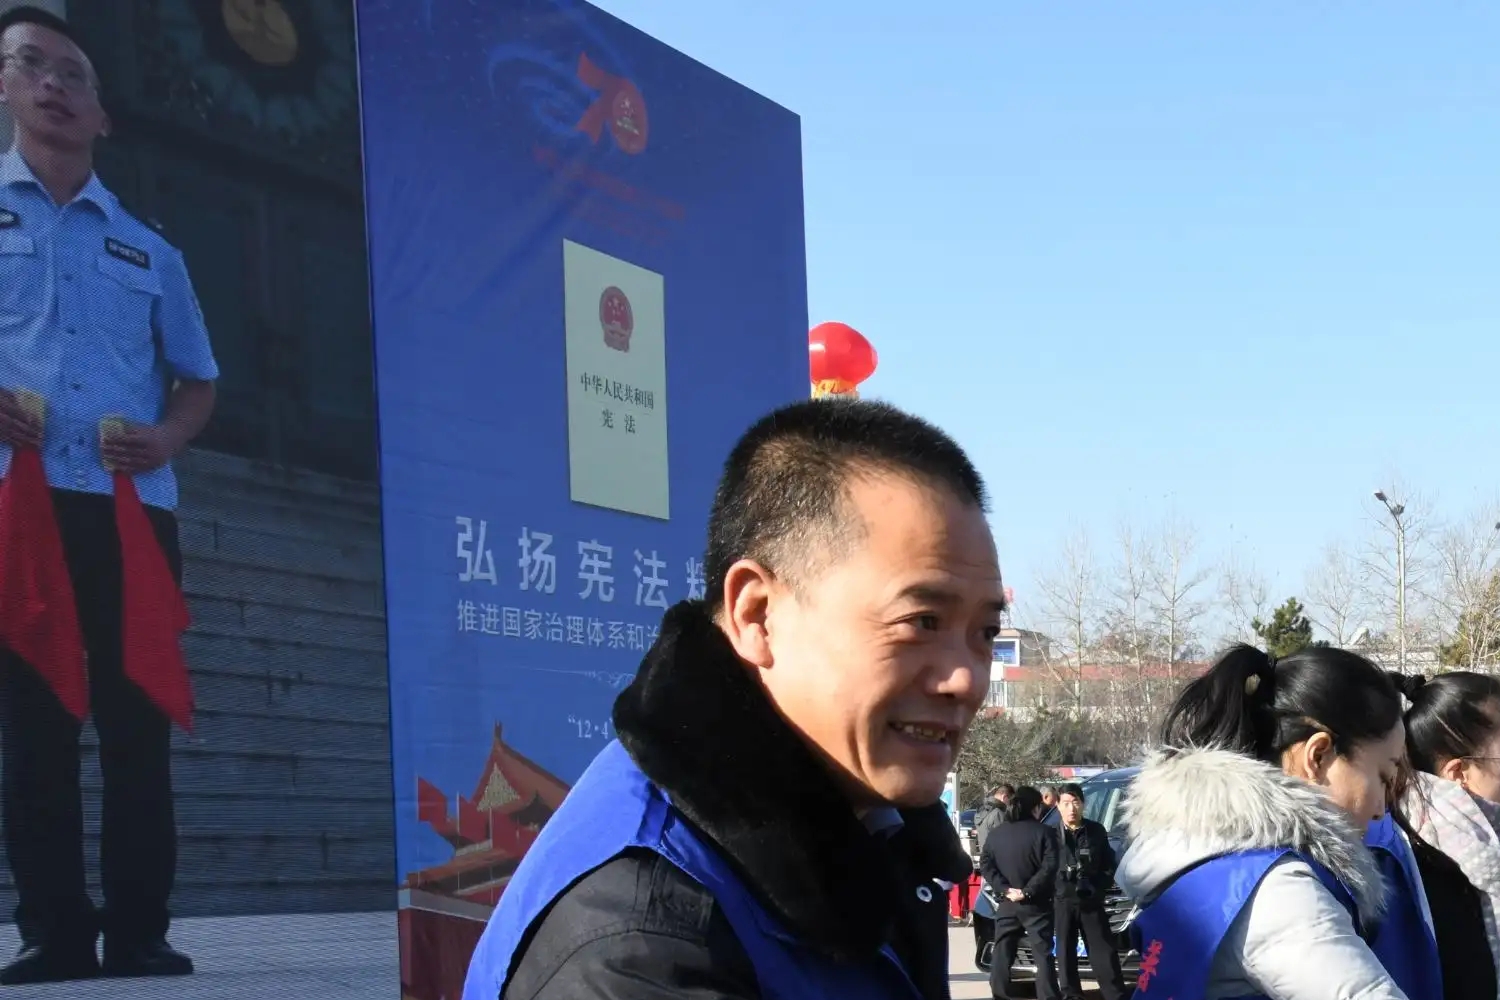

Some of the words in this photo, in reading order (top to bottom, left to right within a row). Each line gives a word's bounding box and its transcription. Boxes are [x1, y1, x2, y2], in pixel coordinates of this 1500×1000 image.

[580, 371, 654, 410] 中华人民共和国
[602, 408, 636, 434] 宪法
